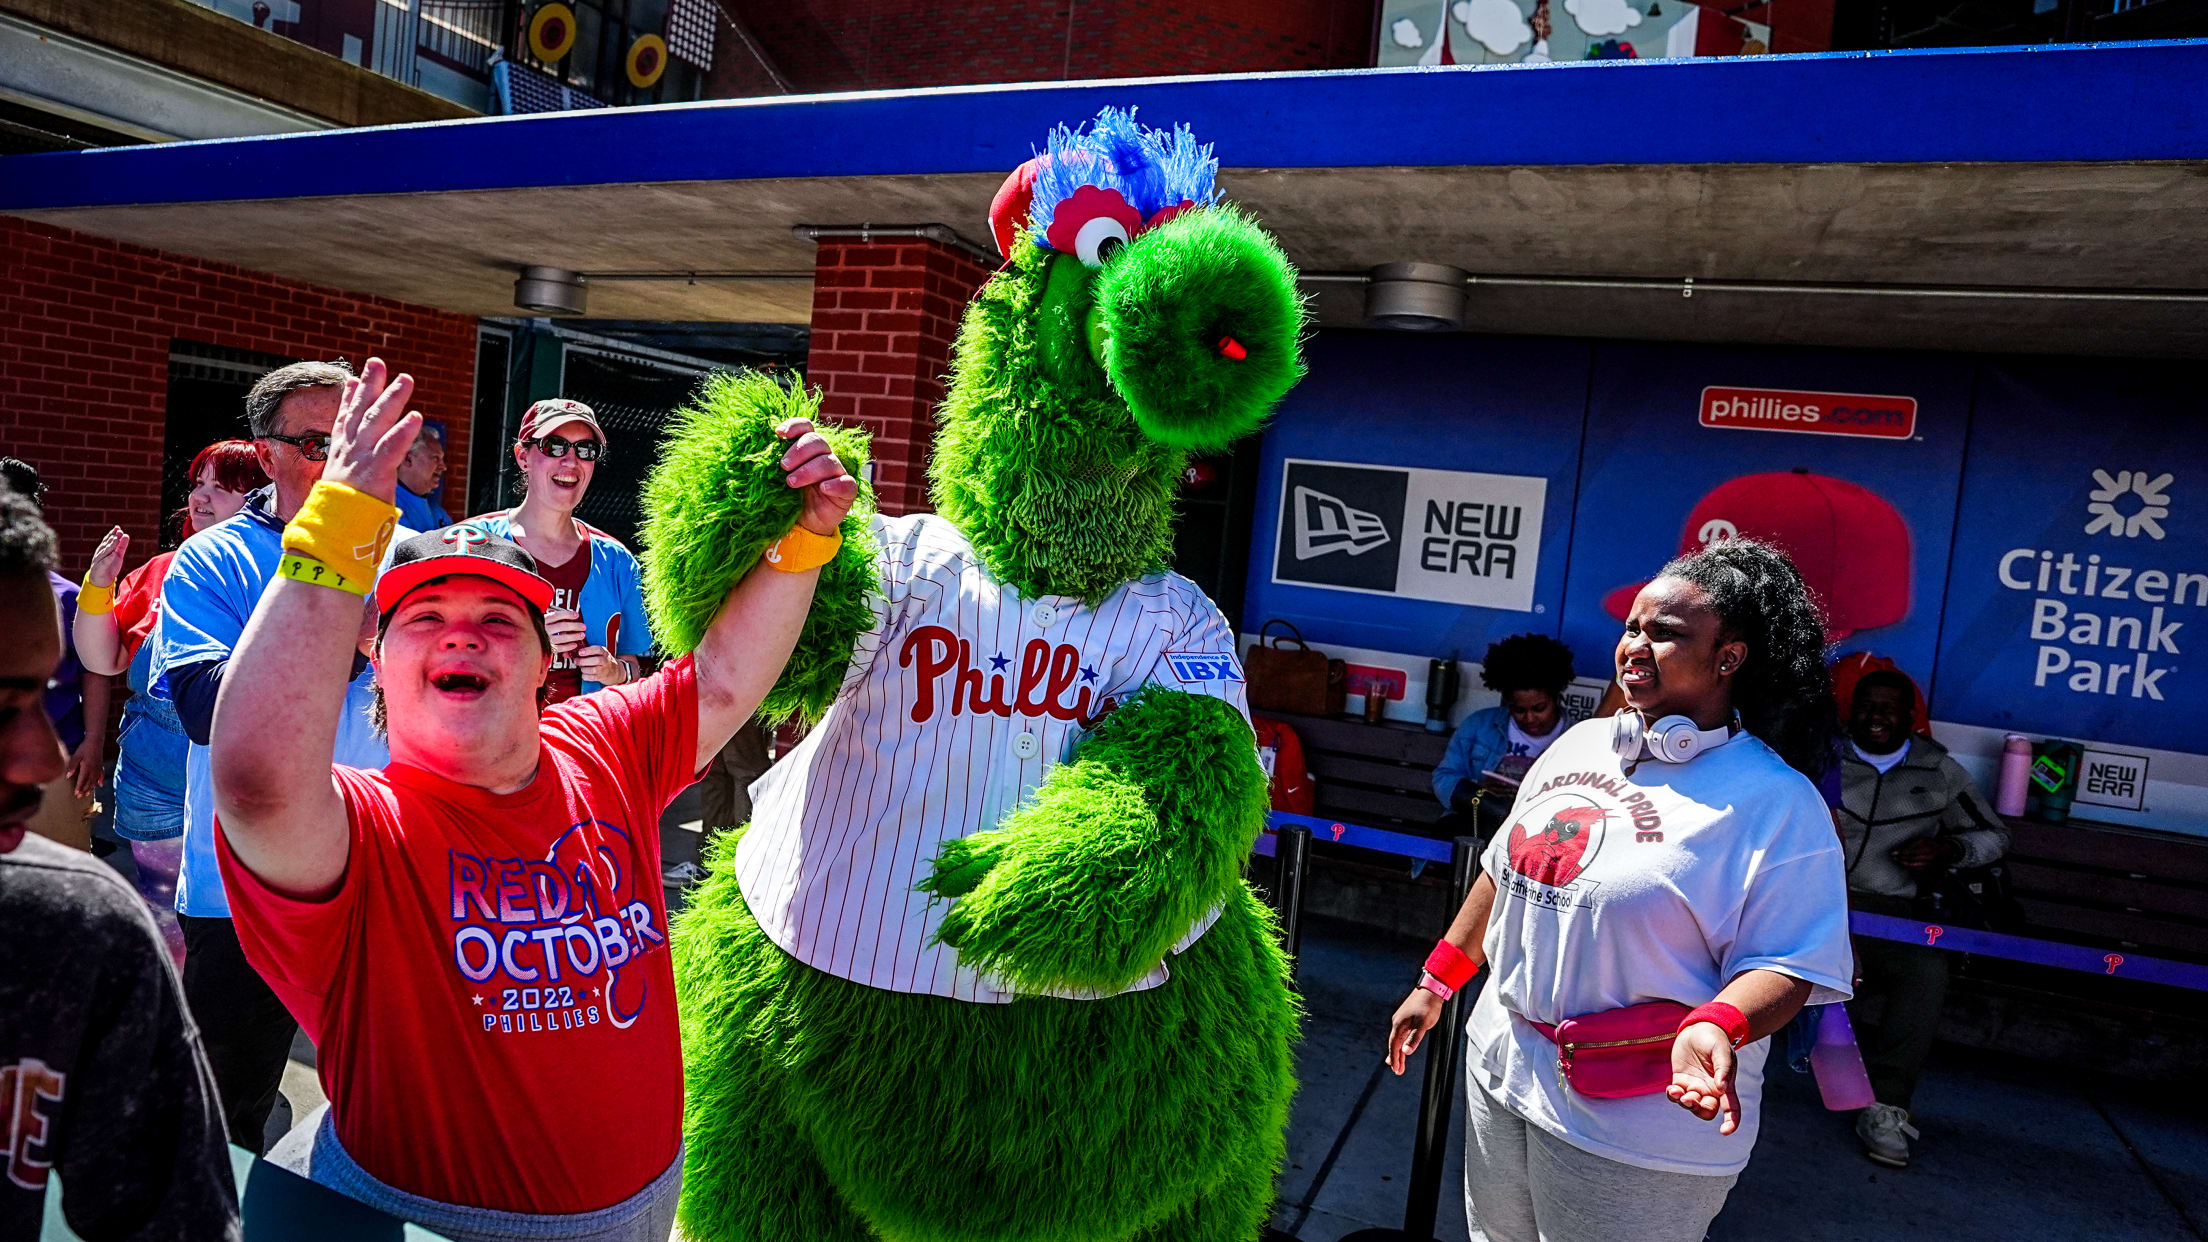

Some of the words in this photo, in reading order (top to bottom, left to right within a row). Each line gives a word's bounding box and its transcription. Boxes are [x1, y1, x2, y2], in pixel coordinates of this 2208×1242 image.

[1709, 396, 1904, 426] phillies.com
[1423, 498, 1522, 541] NEW
[1419, 537, 1518, 580] ERA
[2030, 598, 2184, 655] Bank
[1173, 661, 1242, 680] IBX
[2034, 645, 2168, 701] Park
[1558, 693, 1594, 709] NEW
[2088, 762, 2137, 782] NEW
[2086, 778, 2134, 798] ERA
[1527, 771, 1629, 802] ARDINAL
[1619, 791, 1664, 844] PRIDE
[448, 847, 571, 926] RED
[1545, 890, 1573, 908] School
[454, 900, 665, 984] OCTOBER
[502, 986, 574, 1012] 2022
[482, 1005, 600, 1033] PHILLIES
